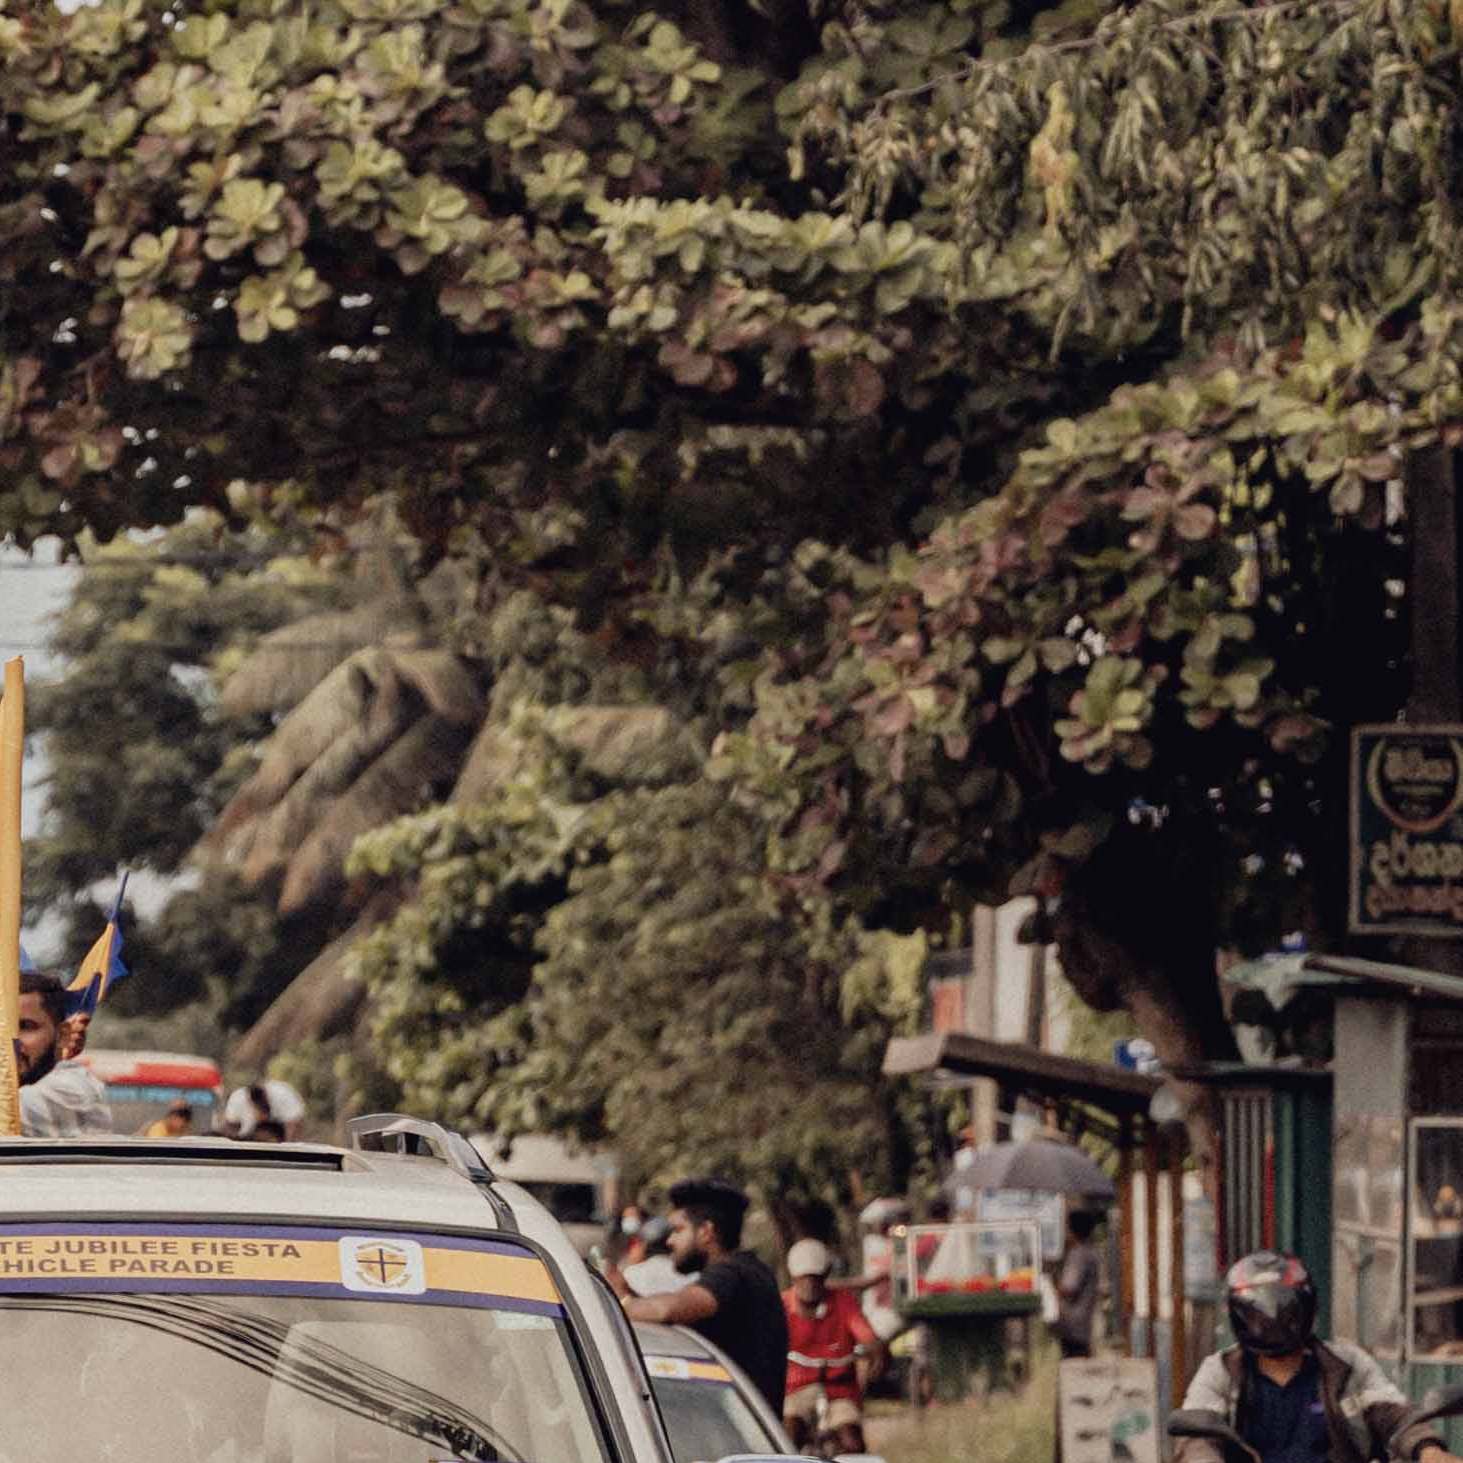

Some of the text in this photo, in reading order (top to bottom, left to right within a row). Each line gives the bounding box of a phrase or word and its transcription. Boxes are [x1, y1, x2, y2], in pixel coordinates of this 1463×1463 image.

[44, 1240, 179, 1256] JUBILEE
[191, 1241, 302, 1259] FIESTA
[109, 1258, 235, 1275] PARADE
